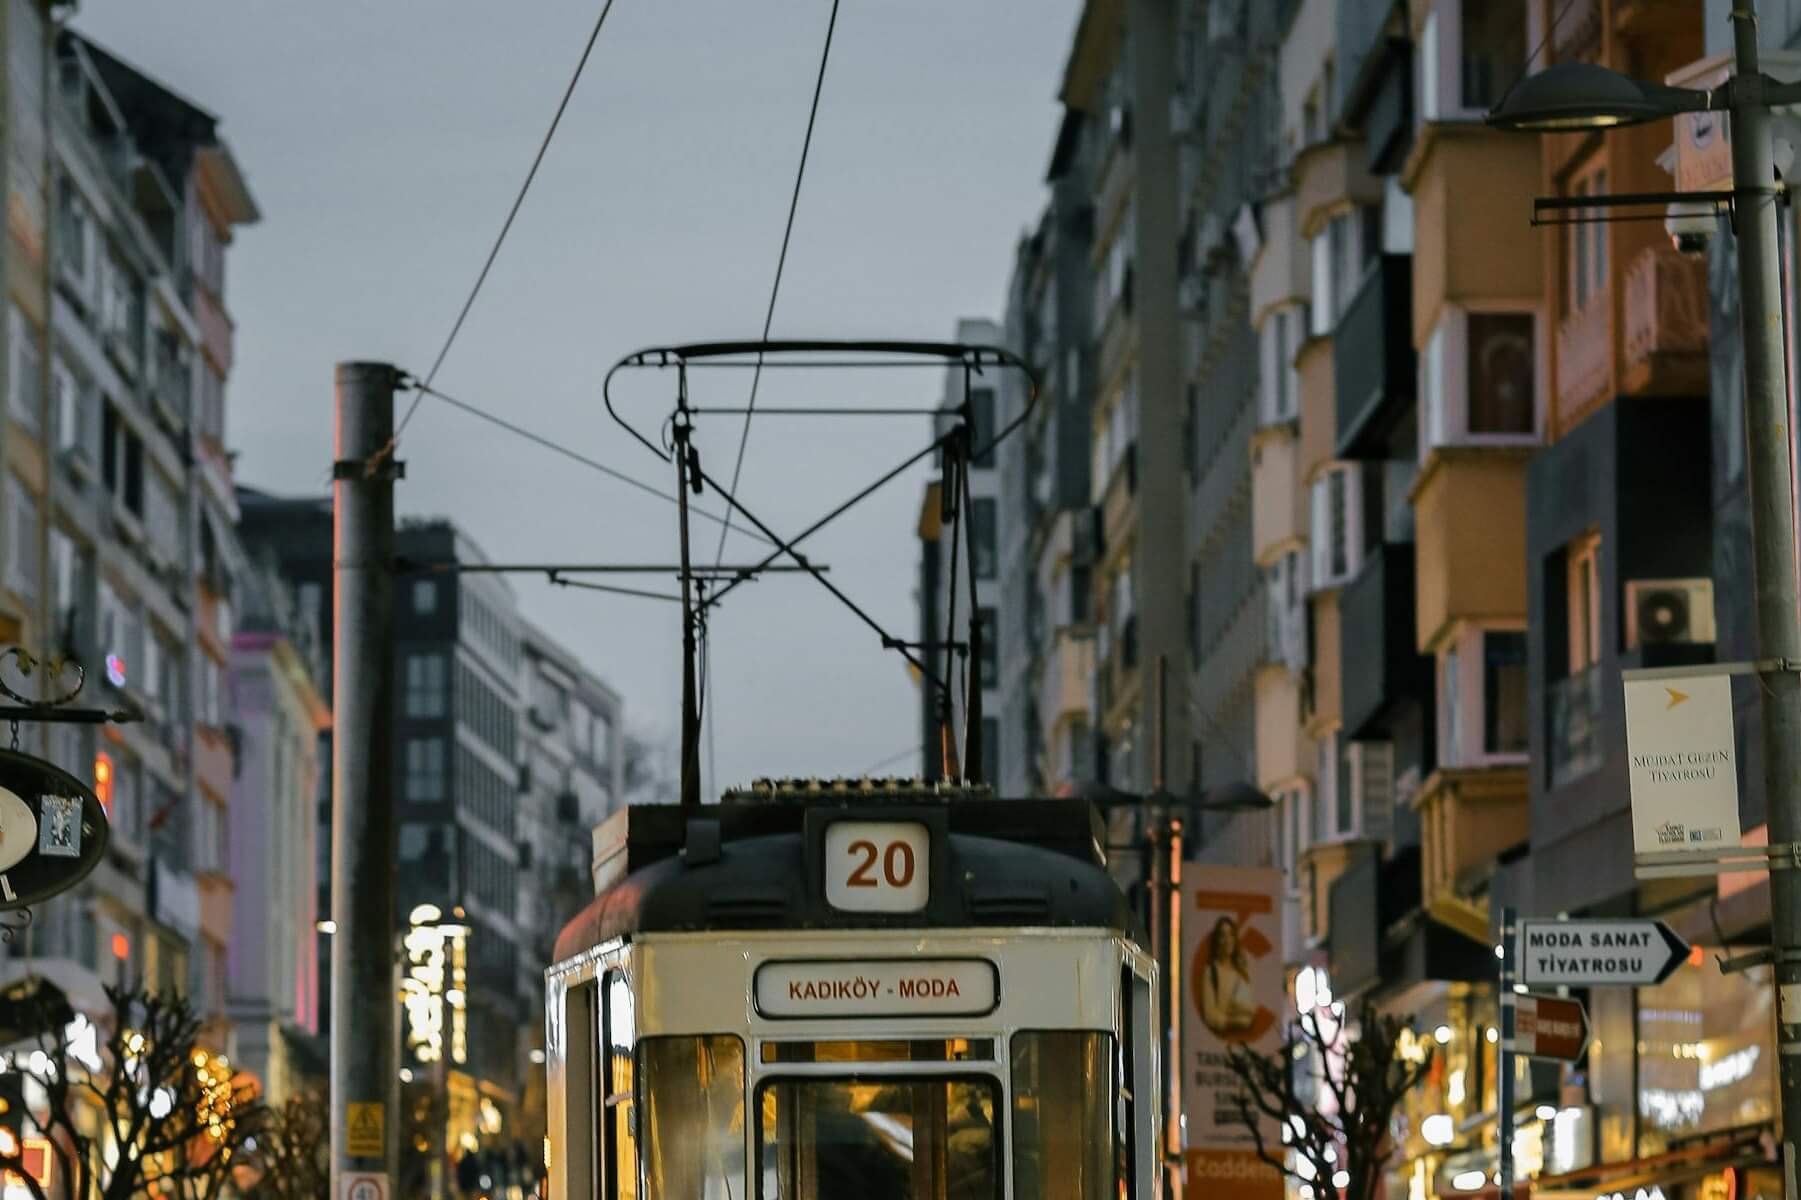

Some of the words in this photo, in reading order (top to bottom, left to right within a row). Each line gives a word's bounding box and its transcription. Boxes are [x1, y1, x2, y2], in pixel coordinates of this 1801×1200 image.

[1687, 751, 1729, 765] GEZEN
[846, 840, 914, 888] 20
[1530, 933, 1582, 947] MODA
[1590, 933, 1651, 947] SANAT
[1538, 954, 1643, 973] TİYATROSU
[788, 976, 880, 1000] KADIKÖY
[899, 977, 960, 998] MODA
